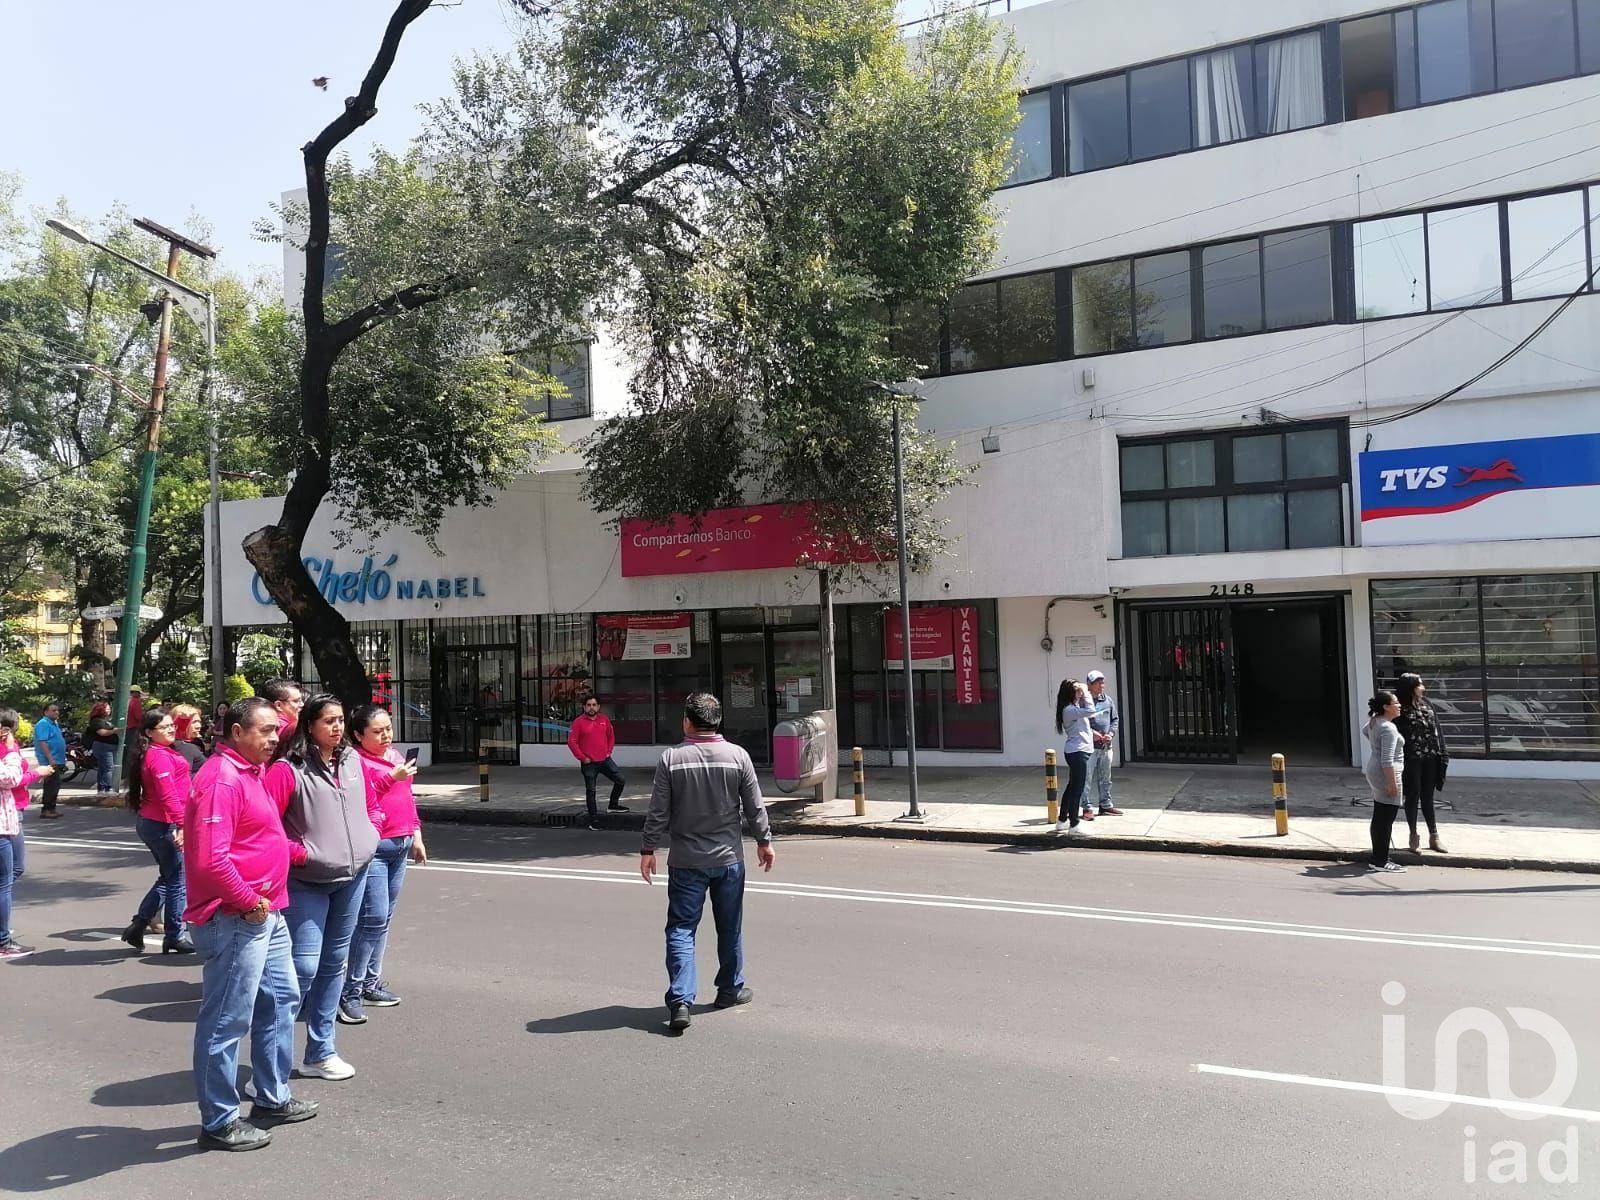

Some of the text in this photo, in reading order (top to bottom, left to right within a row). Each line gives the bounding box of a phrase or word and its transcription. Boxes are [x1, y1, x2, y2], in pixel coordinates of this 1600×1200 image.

[1380, 465, 1449, 492] TVS
[633, 527, 751, 549] Compartamos Banco
[396, 577, 486, 600] NABEL
[1209, 582, 1255, 599] 2148
[960, 607, 973, 704] VACANTES
